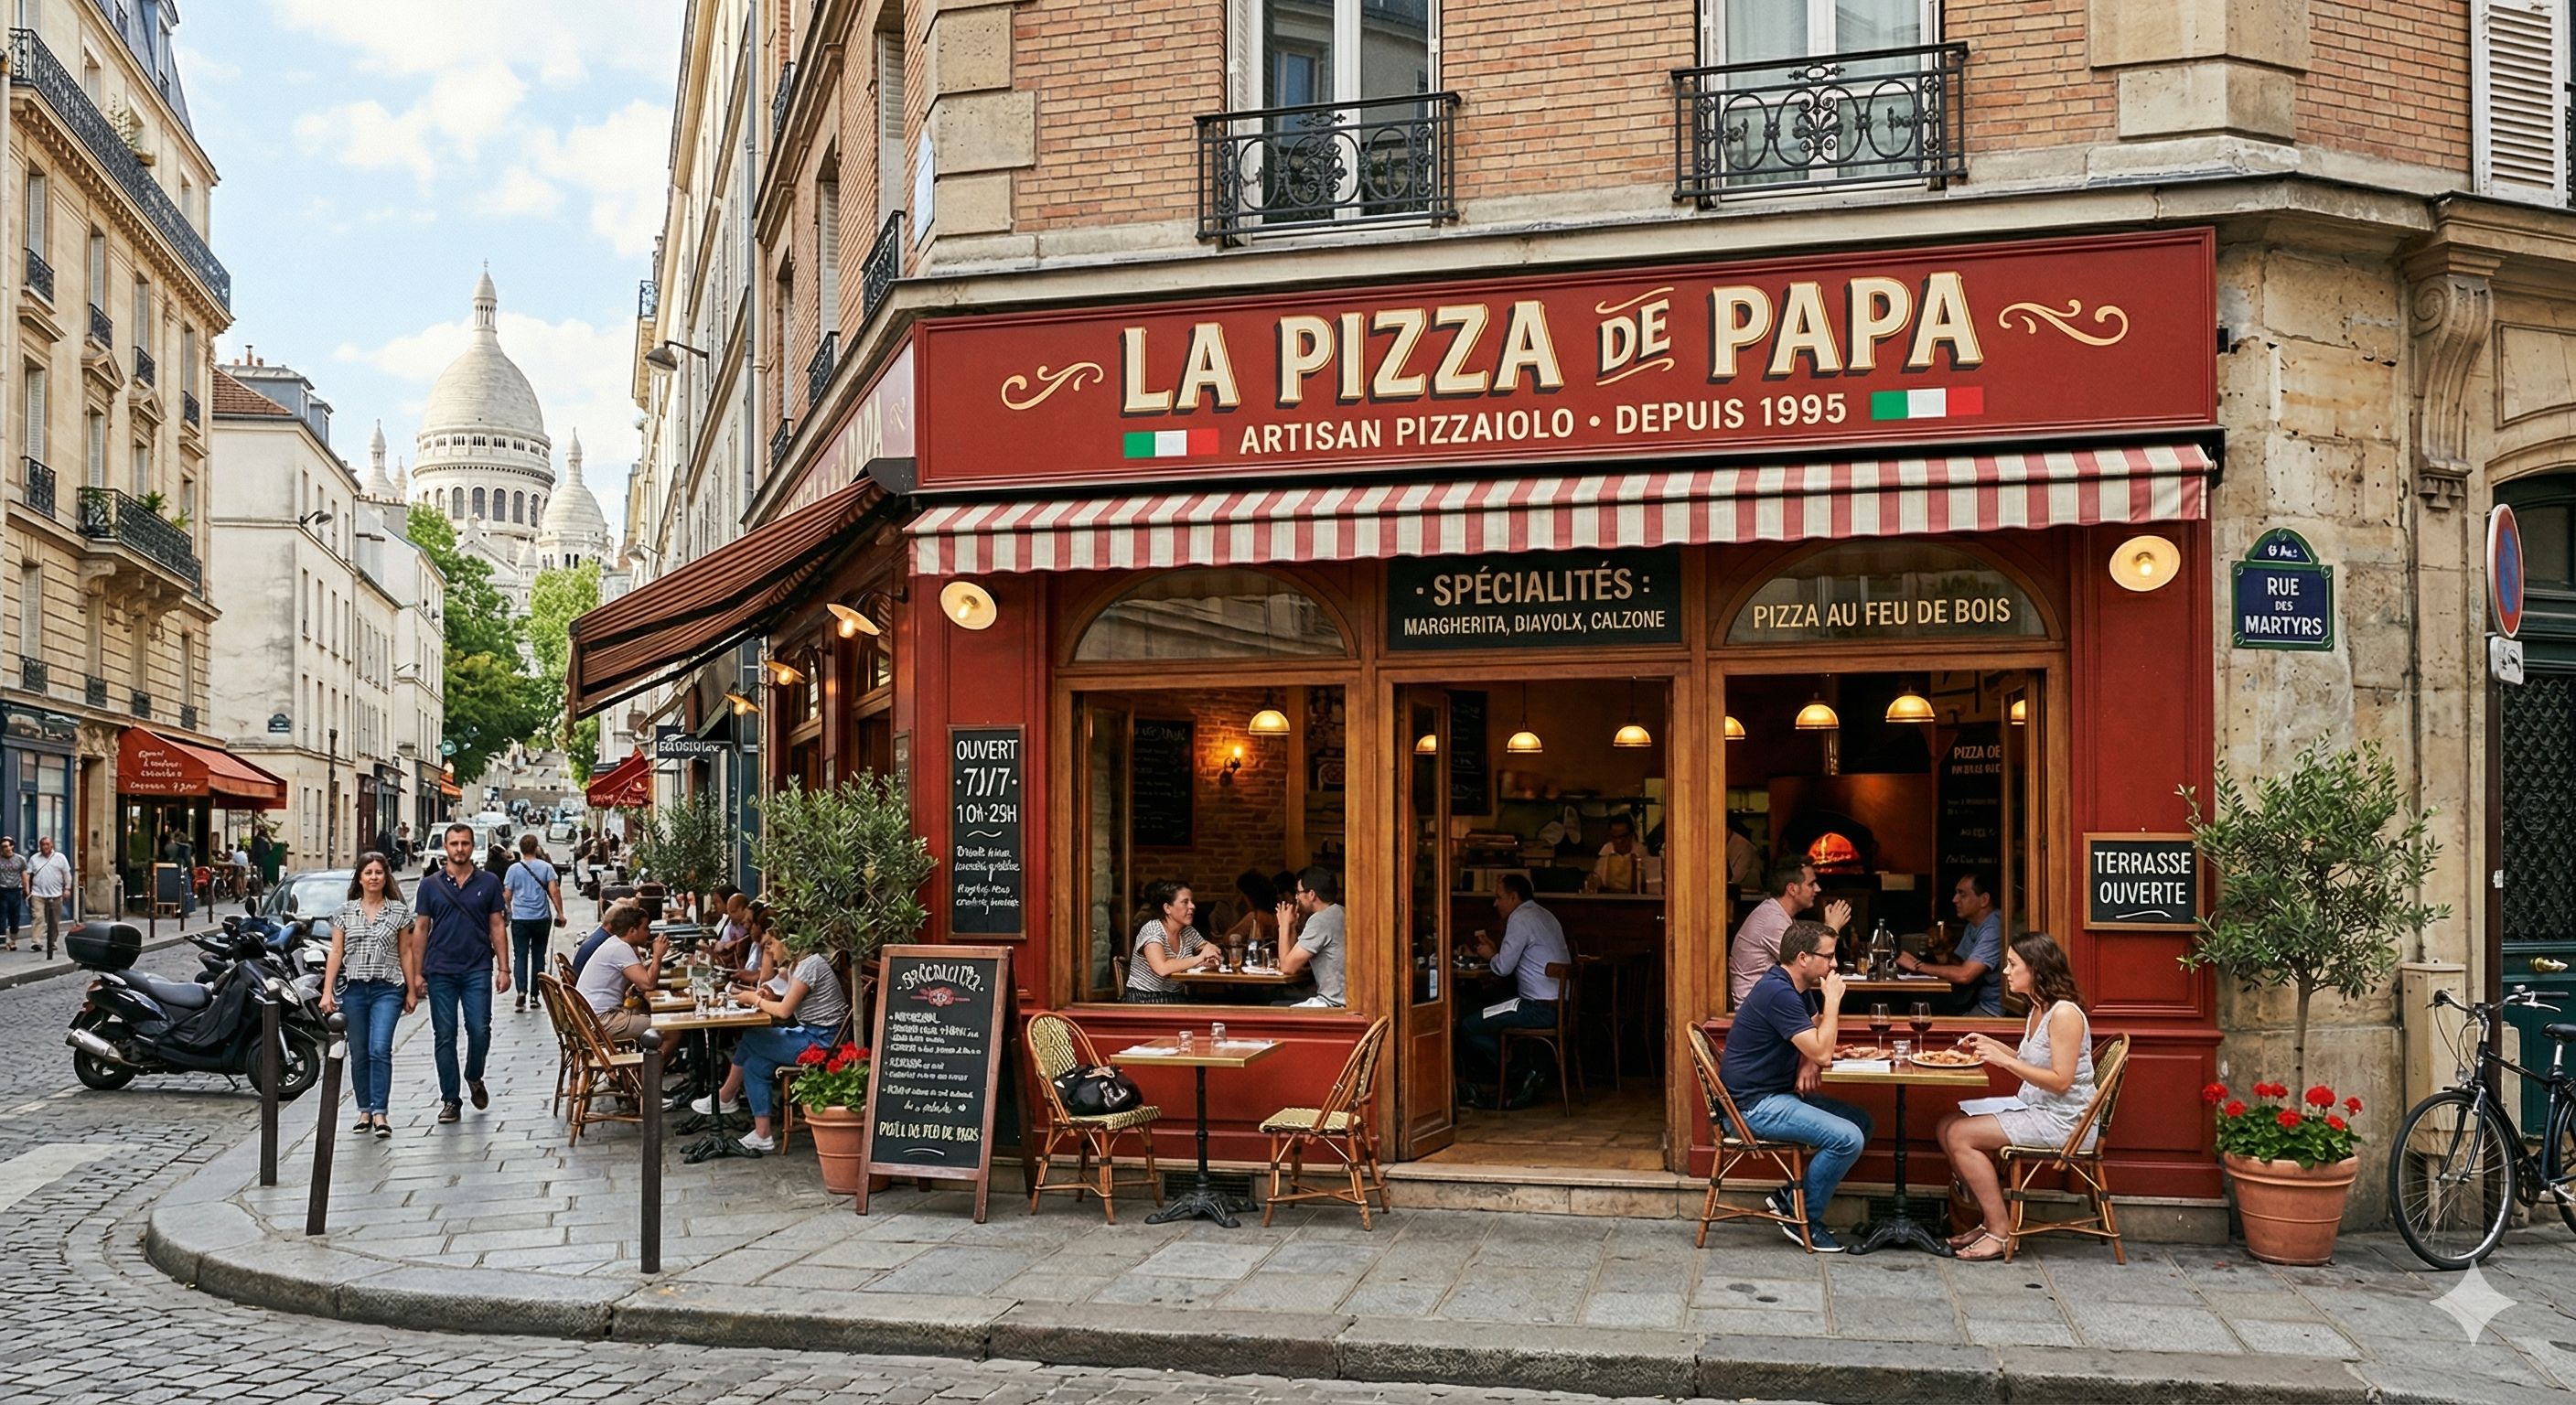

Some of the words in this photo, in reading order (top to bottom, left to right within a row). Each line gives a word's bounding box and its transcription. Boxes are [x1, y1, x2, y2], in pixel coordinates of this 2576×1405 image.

[1122, 322, 1241, 414] LA
[1278, 300, 1564, 404] PIZZA
[1599, 298, 1672, 375] DE
[1711, 272, 1984, 380] PAPA
[1240, 419, 1381, 455] ARTISAN
[1397, 408, 1574, 446] PIZZAIOLO
[1615, 398, 1744, 434] DEPUIS
[1760, 393, 1847, 427] 1995
[1433, 561, 1633, 606] SPÉCIALITÉS
[2267, 577, 2300, 596] RUE
[1754, 604, 1819, 628] PIZZA
[1826, 602, 1857, 627] AU
[1865, 600, 1909, 626] FEU
[1917, 599, 1948, 624] DE
[1955, 597, 2011, 623] BOIS
[2275, 601, 2293, 611] DES
[1404, 616, 1510, 636] MARGHERITA,
[1592, 610, 1666, 630] CALZONE
[2245, 616, 2323, 635] MARTYRS
[956, 739, 1018, 760] OUVERT
[1954, 745, 1984, 759] PIZZA
[2094, 852, 2192, 874] TERRASSE
[2099, 882, 2186, 905] OUVERTE
